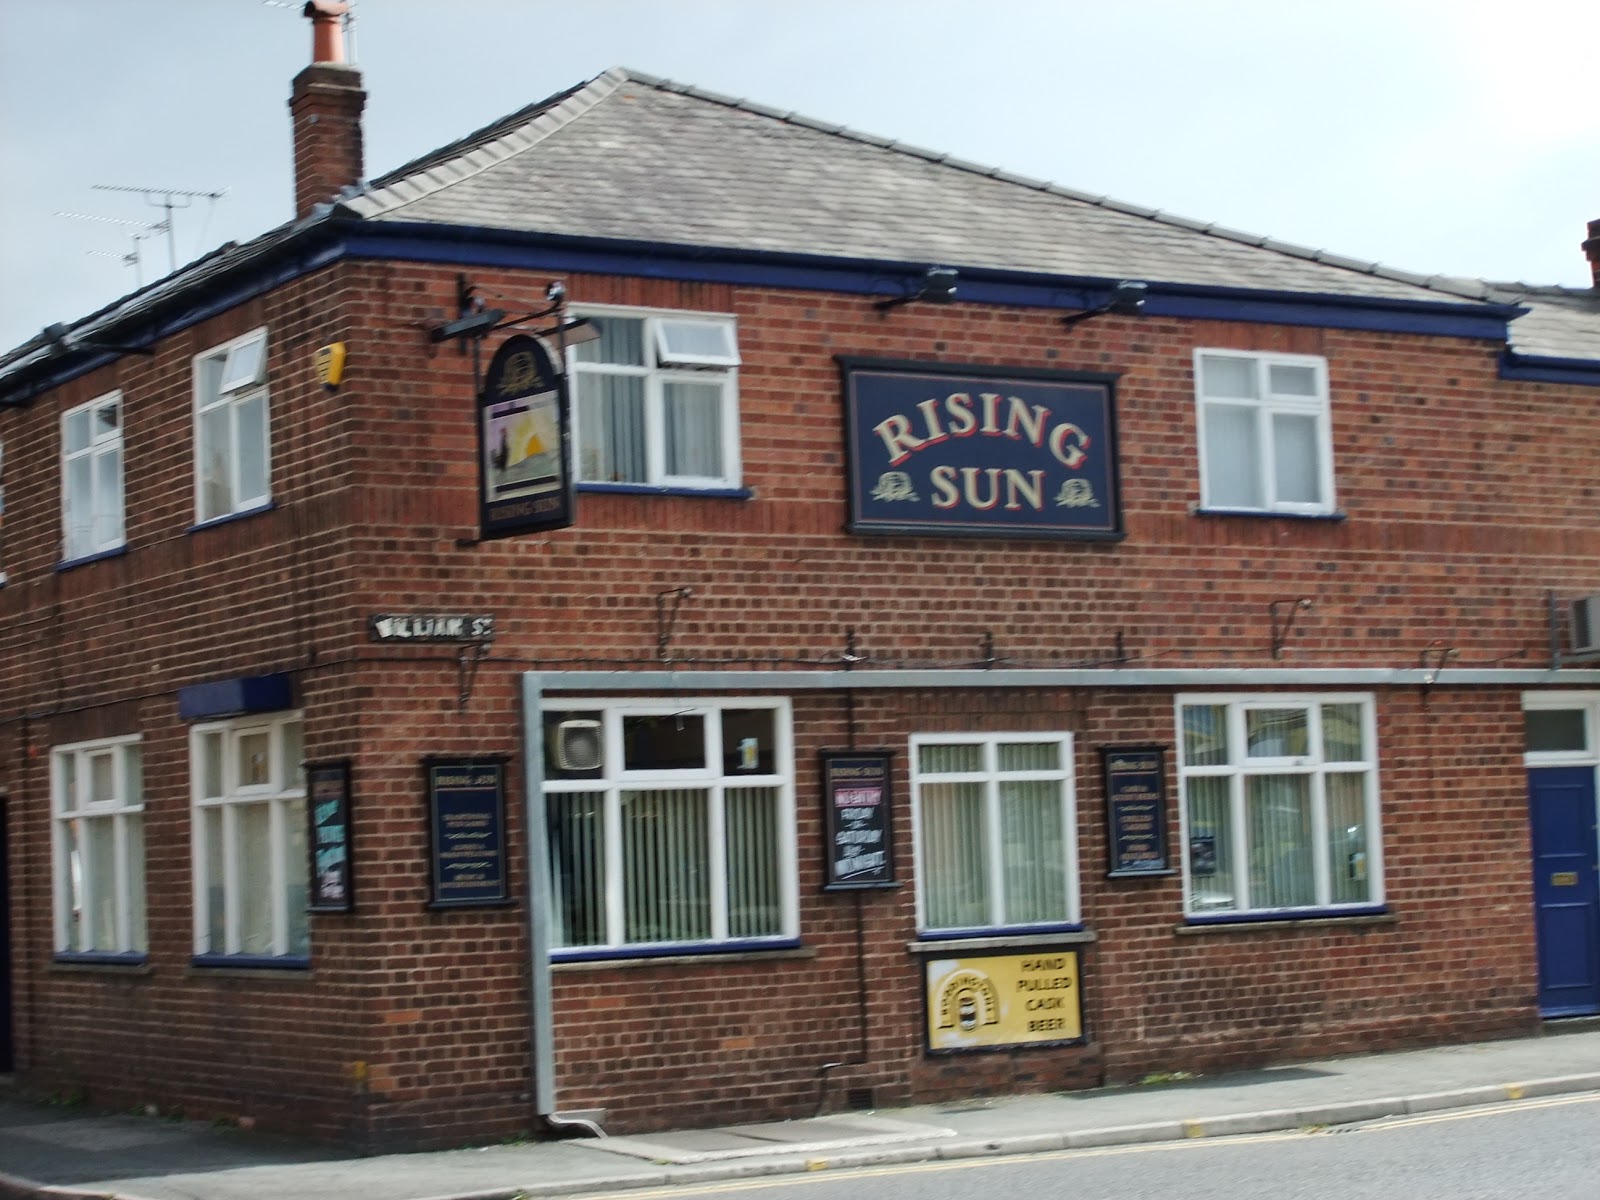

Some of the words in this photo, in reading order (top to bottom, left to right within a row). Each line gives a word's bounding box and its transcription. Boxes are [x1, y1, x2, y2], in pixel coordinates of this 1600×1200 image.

[872, 392, 1092, 470] RISING
[929, 464, 1046, 512] SUN
[375, 617, 463, 638] WILLIAM
[1020, 956, 1067, 973] HAND
[1016, 976, 1072, 993] PULLED
[1024, 996, 1066, 1012] CASK
[1026, 1017, 1067, 1033] BEER
